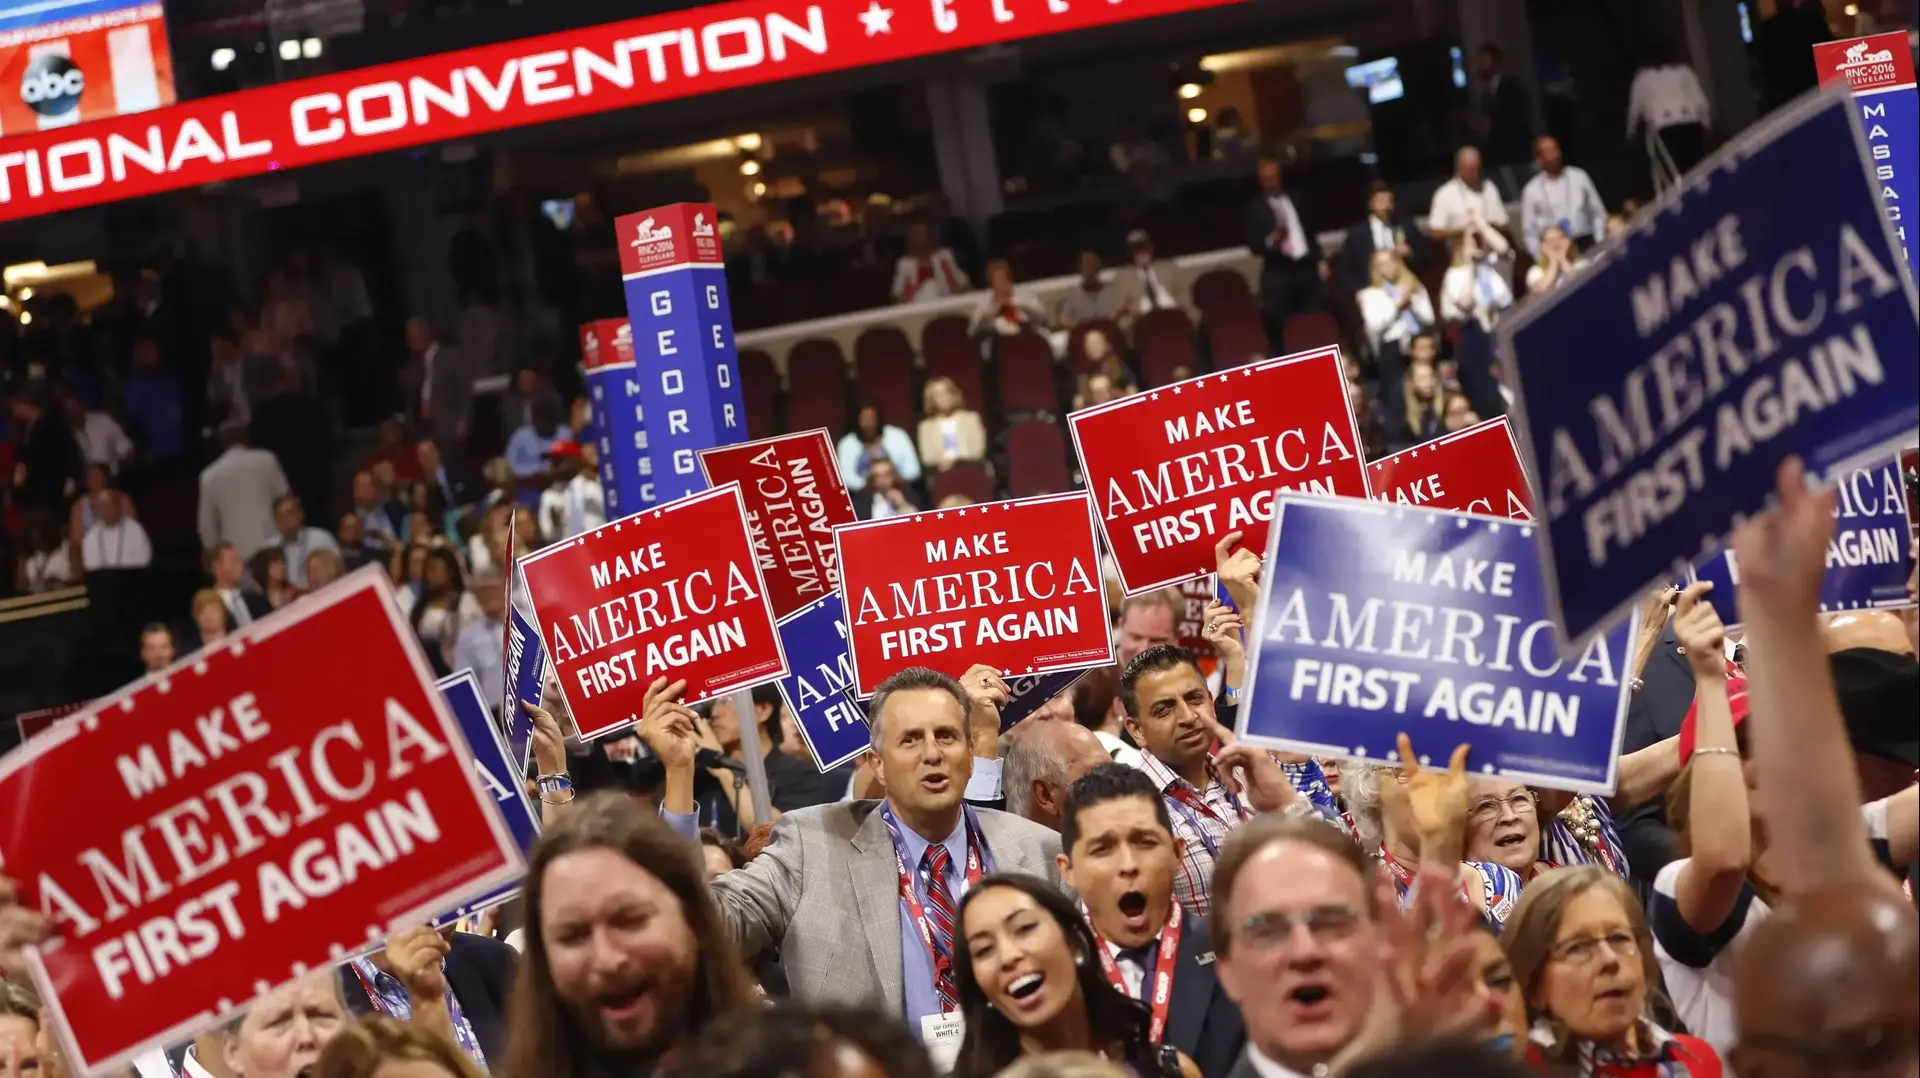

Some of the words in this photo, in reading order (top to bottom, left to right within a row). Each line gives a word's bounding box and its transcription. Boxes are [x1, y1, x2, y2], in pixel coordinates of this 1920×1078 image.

[0, 111, 272, 201] TIONAL
[291, 8, 828, 147] CONVENTION
[20, 68, 84, 103] abc
[1630, 213, 1747, 337] MAKE
[1549, 223, 1898, 514] AMERICA
[1164, 399, 1255, 445] MAKE
[1583, 427, 1706, 566] FIRST
[1715, 324, 1884, 471] AGAIN
[787, 457, 832, 534] AGAIN
[1106, 421, 1354, 521] AMERICA
[590, 542, 666, 589] MAKE
[749, 445, 825, 596] MERICA
[925, 531, 1009, 563] MAKE
[1132, 503, 1218, 555] FIRST
[552, 560, 758, 665] AMERICA
[855, 557, 1097, 626] AMERICA
[1393, 550, 1516, 597] MAKE
[576, 649, 637, 698] FIRST
[646, 617, 747, 676] AGAIN
[880, 620, 966, 660] FIRST
[975, 606, 1079, 646] AGAIN
[1264, 587, 1619, 687] AMERICA
[1290, 659, 1420, 714] FIRST
[1424, 677, 1581, 737] AGAIN
[116, 692, 270, 800] MAKE
[38, 698, 448, 938] AMERICA
[93, 880, 245, 1001] FIRST
[257, 789, 440, 923] AGAIN
